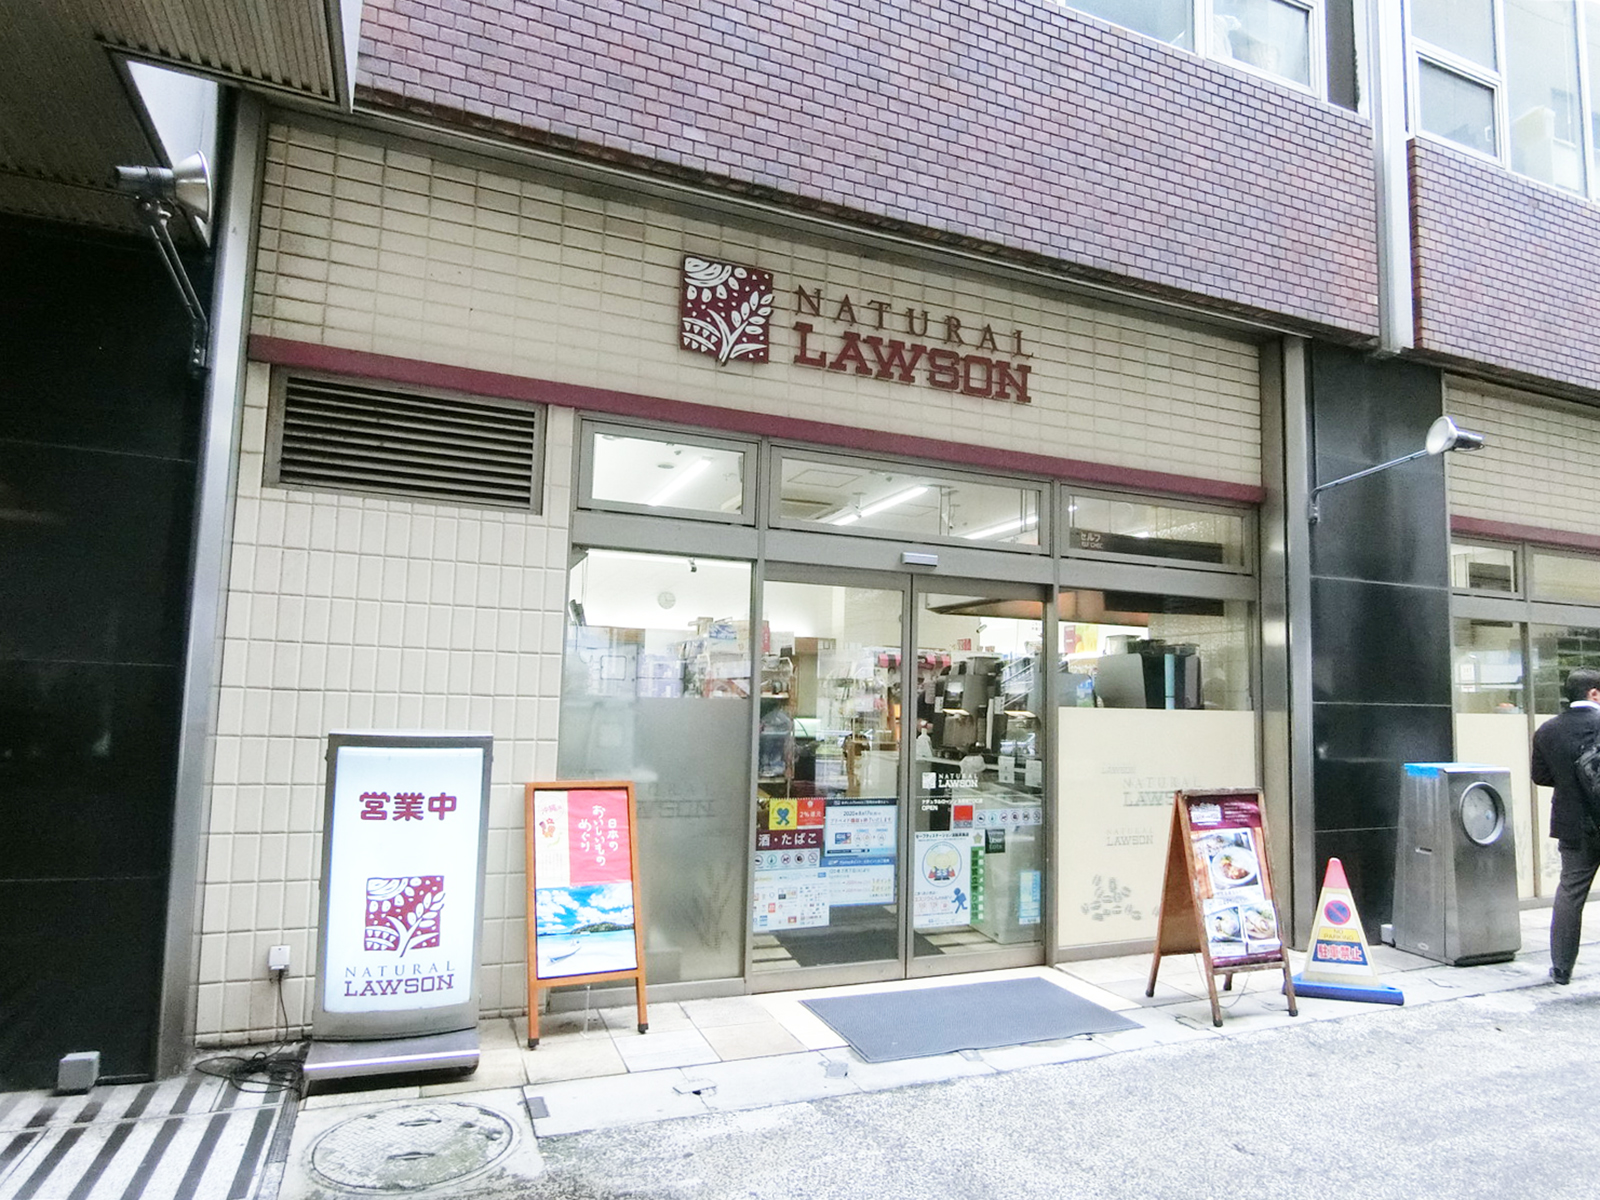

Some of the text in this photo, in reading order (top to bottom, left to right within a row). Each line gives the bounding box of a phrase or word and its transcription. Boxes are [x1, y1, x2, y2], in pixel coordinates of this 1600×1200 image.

[795, 285, 1034, 358] NATURAL
[793, 321, 1032, 403] LAWSON
[938, 780, 979, 788] LAWSON
[1123, 776, 1202, 790] NATURAL
[359, 791, 457, 821] 営業中
[578, 818, 592, 853] めぐり
[592, 805, 606, 867] おいしいもの
[607, 818, 619, 852] 日本の
[758, 833, 817, 847] 酒・たばこ
[1106, 835, 1154, 847] LAWSON
[1323, 933, 1355, 941] PARKING
[1317, 943, 1364, 962] 駐車禁止
[345, 961, 456, 978] NATURAL
[344, 974, 455, 997] LAWSON
